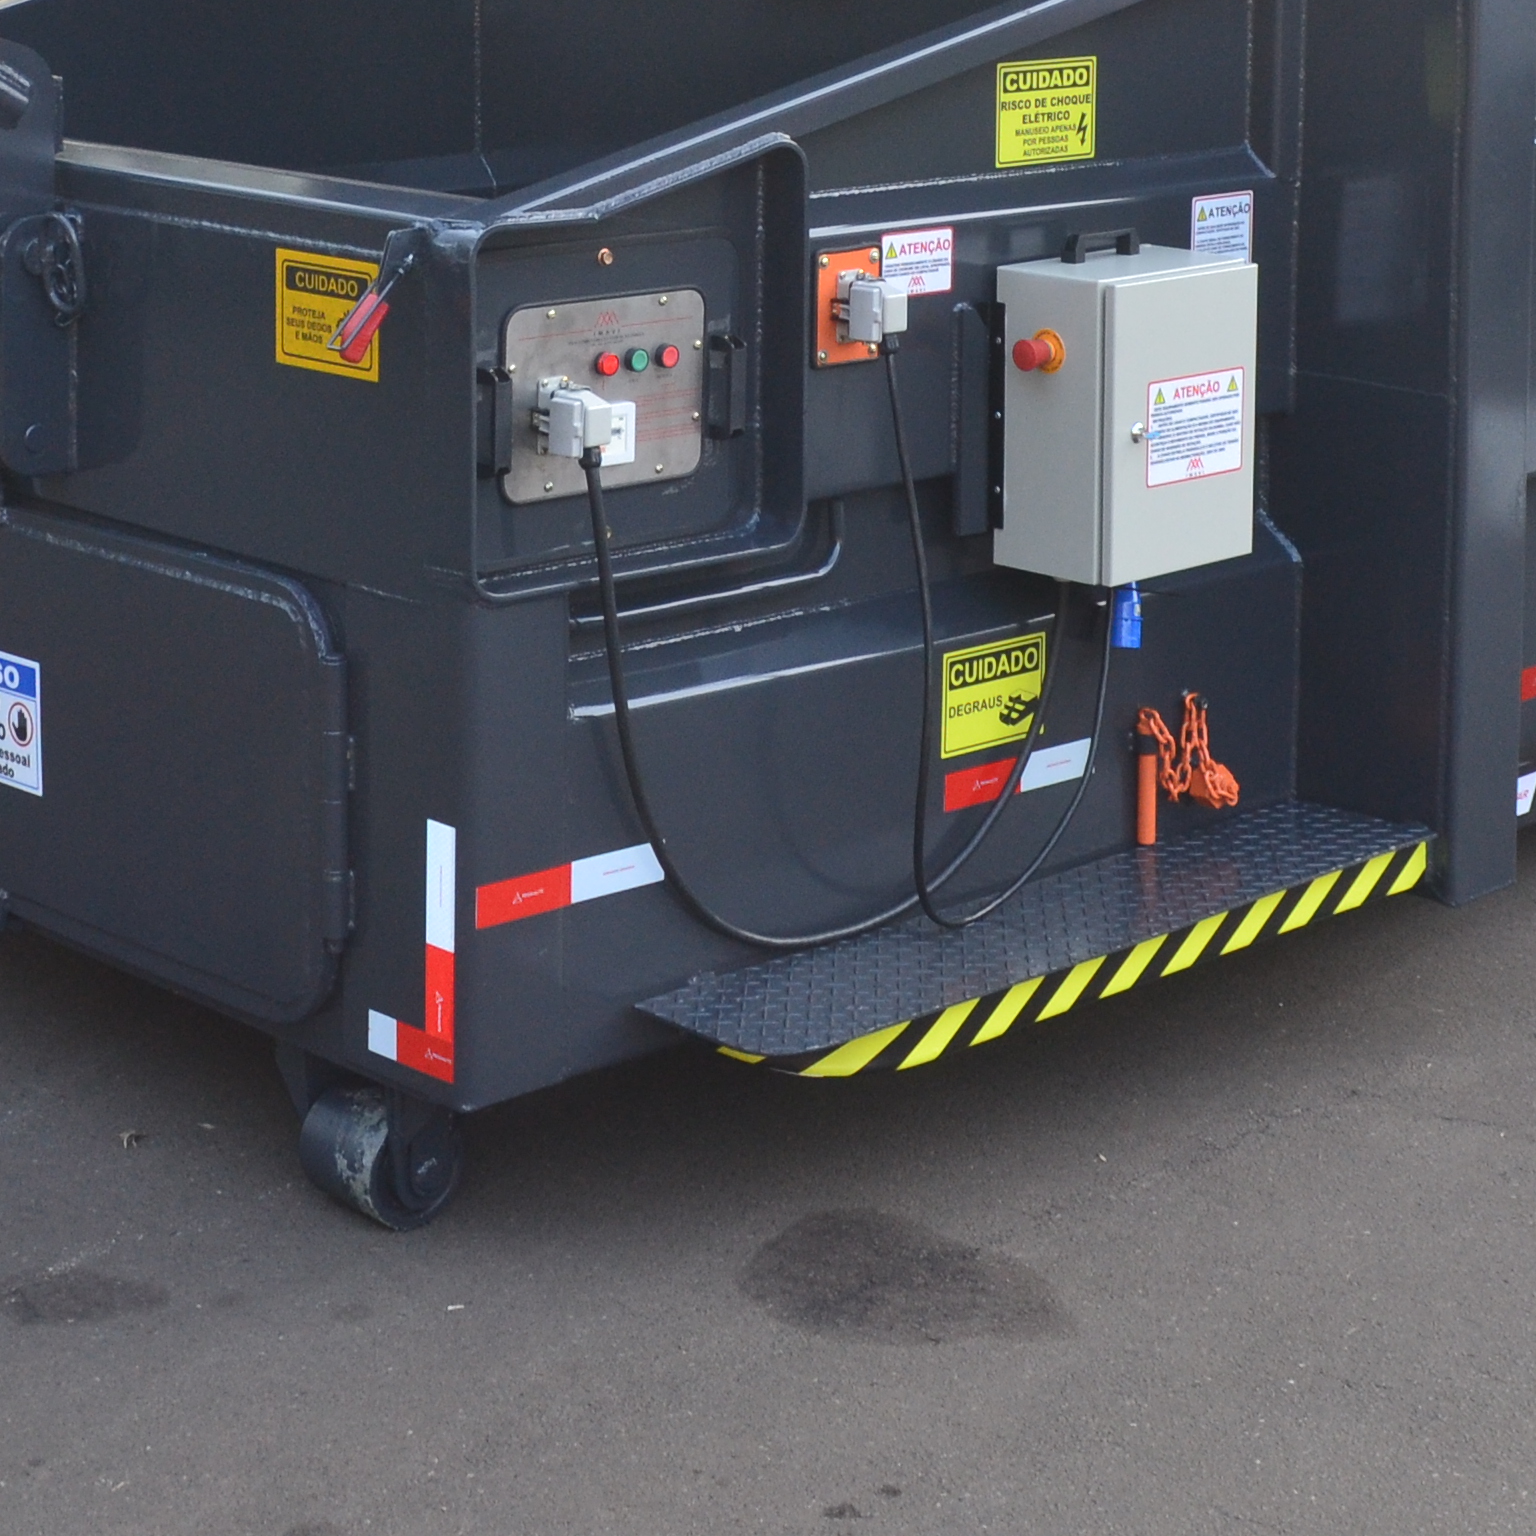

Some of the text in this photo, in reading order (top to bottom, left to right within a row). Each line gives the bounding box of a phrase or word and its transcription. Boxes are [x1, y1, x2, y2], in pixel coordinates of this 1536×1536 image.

[1005, 68, 1088, 91] CUIDADO
[1001, 94, 1092, 111] RISCO DE CHOQUE
[1015, 123, 1076, 136] MANUSEIO APENAS
[1023, 134, 1068, 146] POR PESSOAS
[1023, 145, 1068, 156] AUTORIZADAS
[1208, 201, 1251, 218] ATENÇÃO
[899, 237, 951, 256] ATENÇÃO
[295, 271, 358, 297] CUIDADO
[292, 305, 326, 320] PROTEJA
[295, 331, 300, 340] E
[1173, 380, 1221, 399] ATENÇÃO
[950, 646, 1038, 687] CUIDADO
[948, 695, 1003, 719] DEGRAUS
